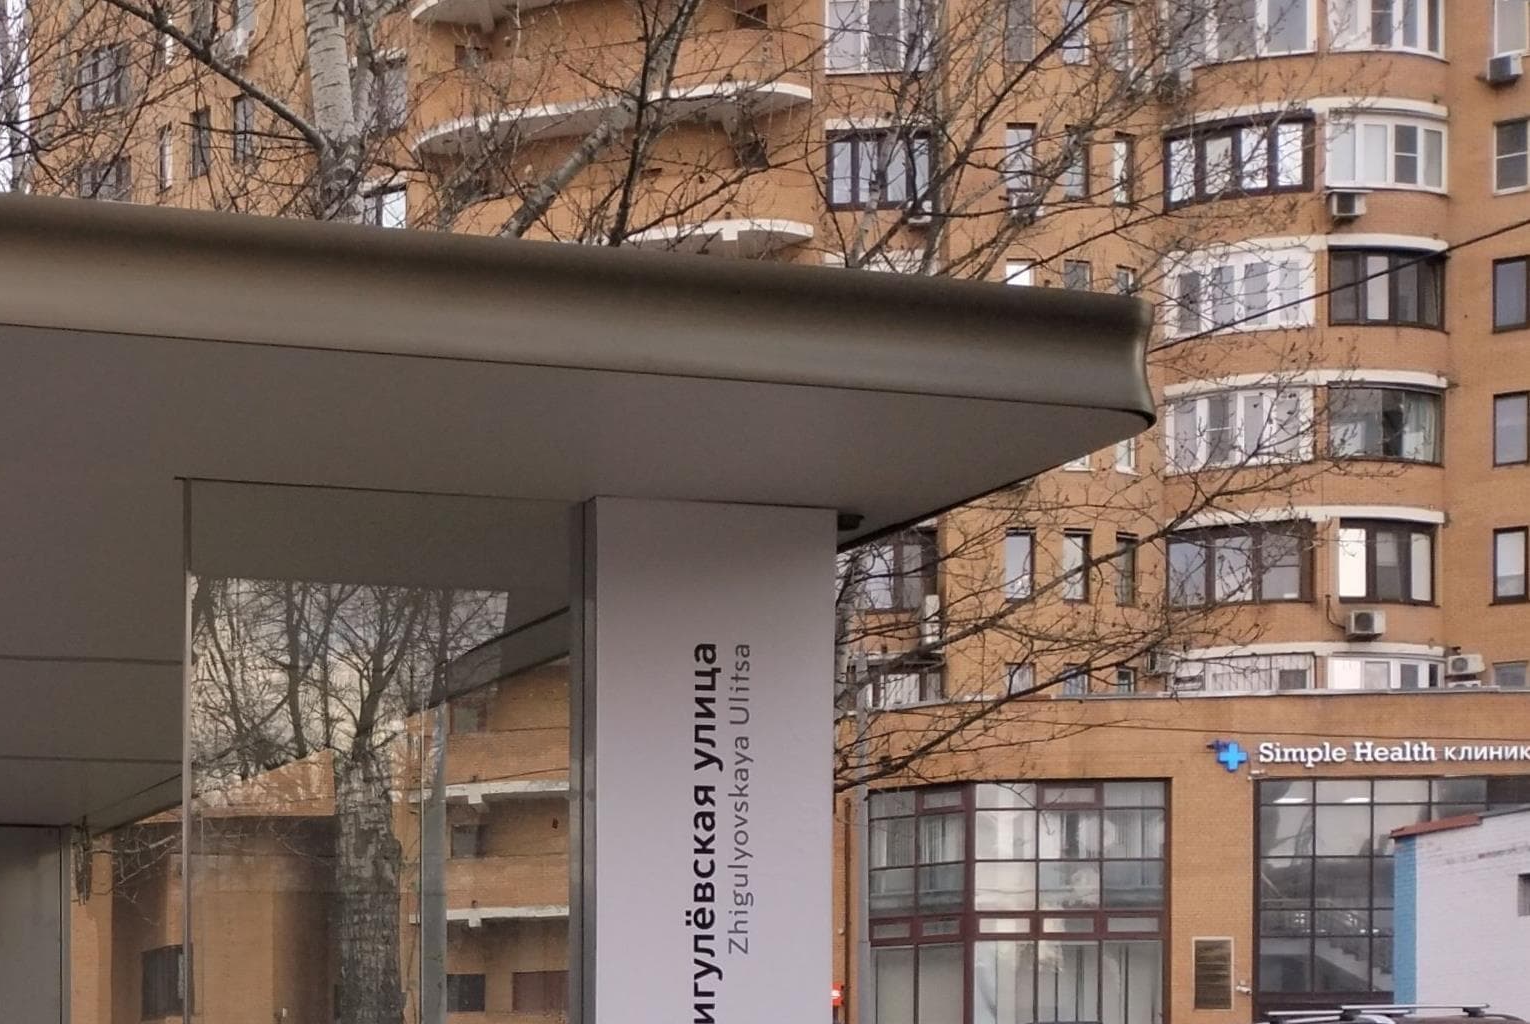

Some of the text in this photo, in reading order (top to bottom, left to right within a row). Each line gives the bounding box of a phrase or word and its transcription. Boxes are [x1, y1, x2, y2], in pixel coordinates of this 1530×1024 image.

[693, 642, 723, 772] улица
[1258, 742, 1348, 768] Simple
[1353, 741, 1437, 763] Health
[728, 643, 755, 954] Zhigulyovskaya Ulitsa
